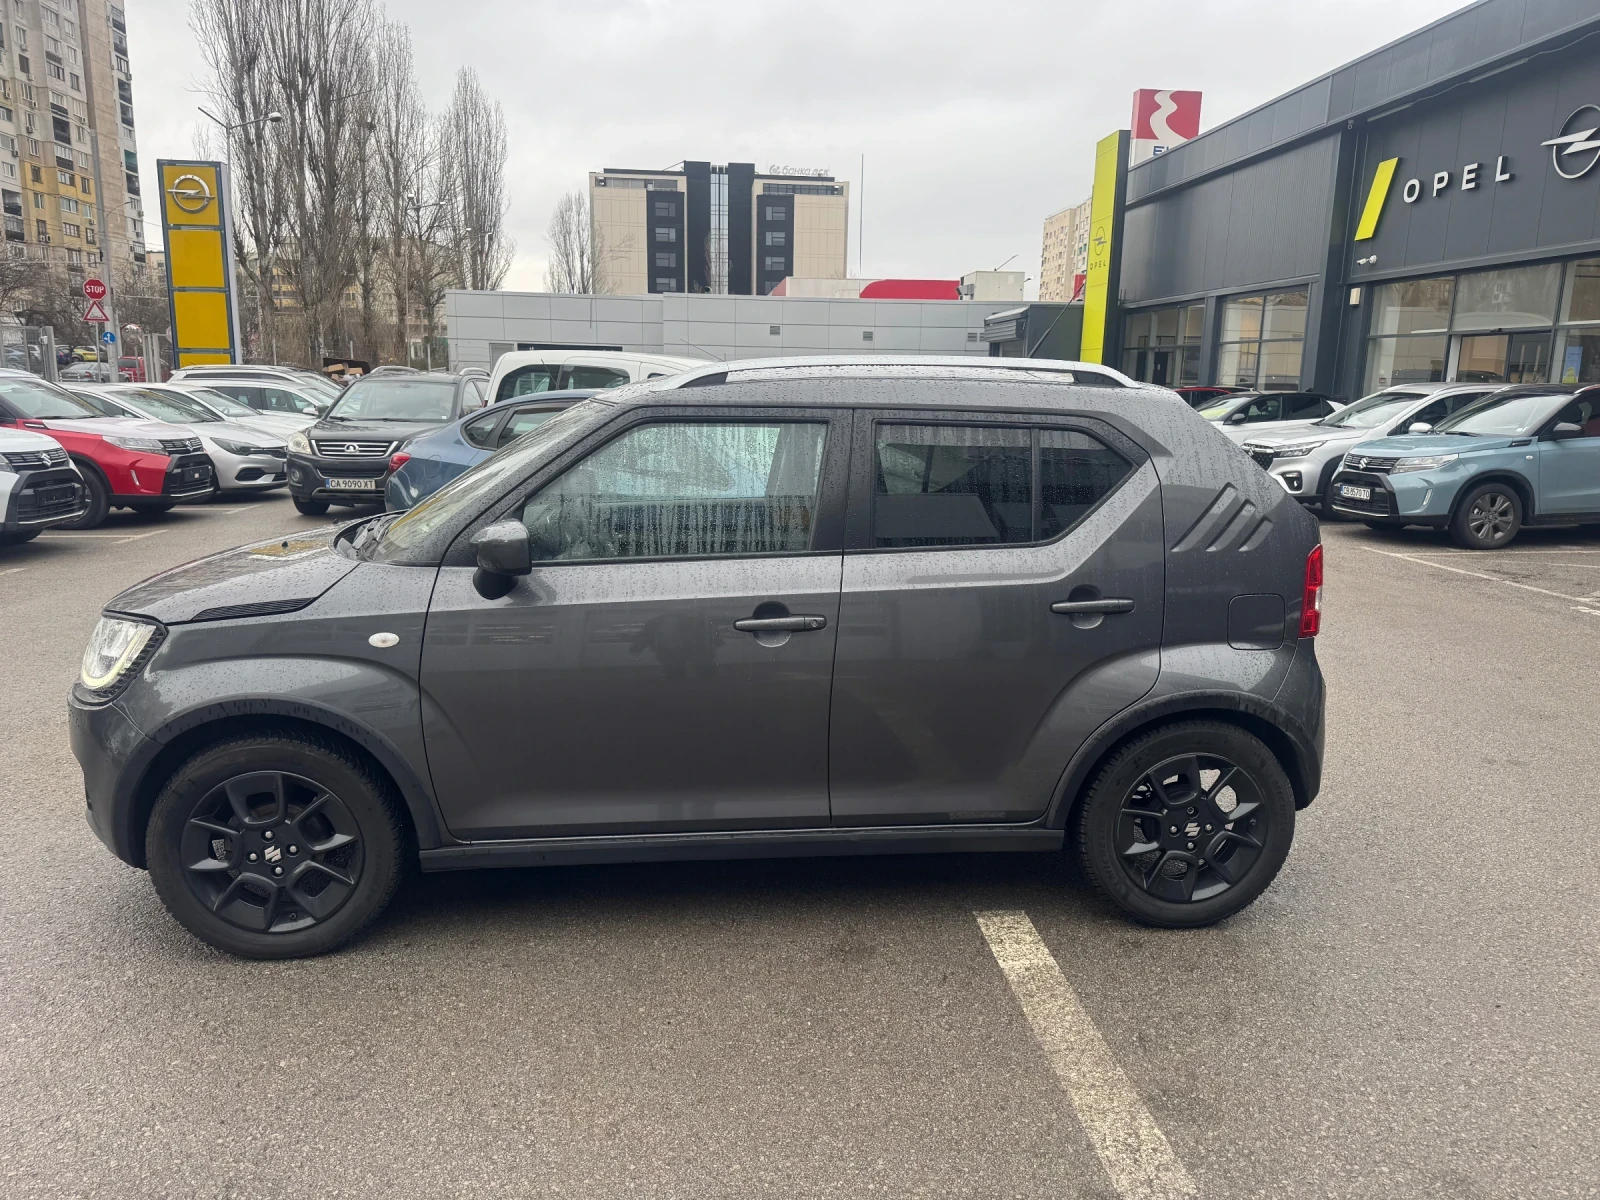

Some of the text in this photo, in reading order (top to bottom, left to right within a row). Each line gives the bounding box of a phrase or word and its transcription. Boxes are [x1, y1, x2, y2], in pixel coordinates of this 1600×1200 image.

[1403, 155, 1510, 203] OPEL
[1090, 260, 1106, 270] OPEL
[86, 285, 105, 294] STOP
[342, 480, 362, 488] 9090
